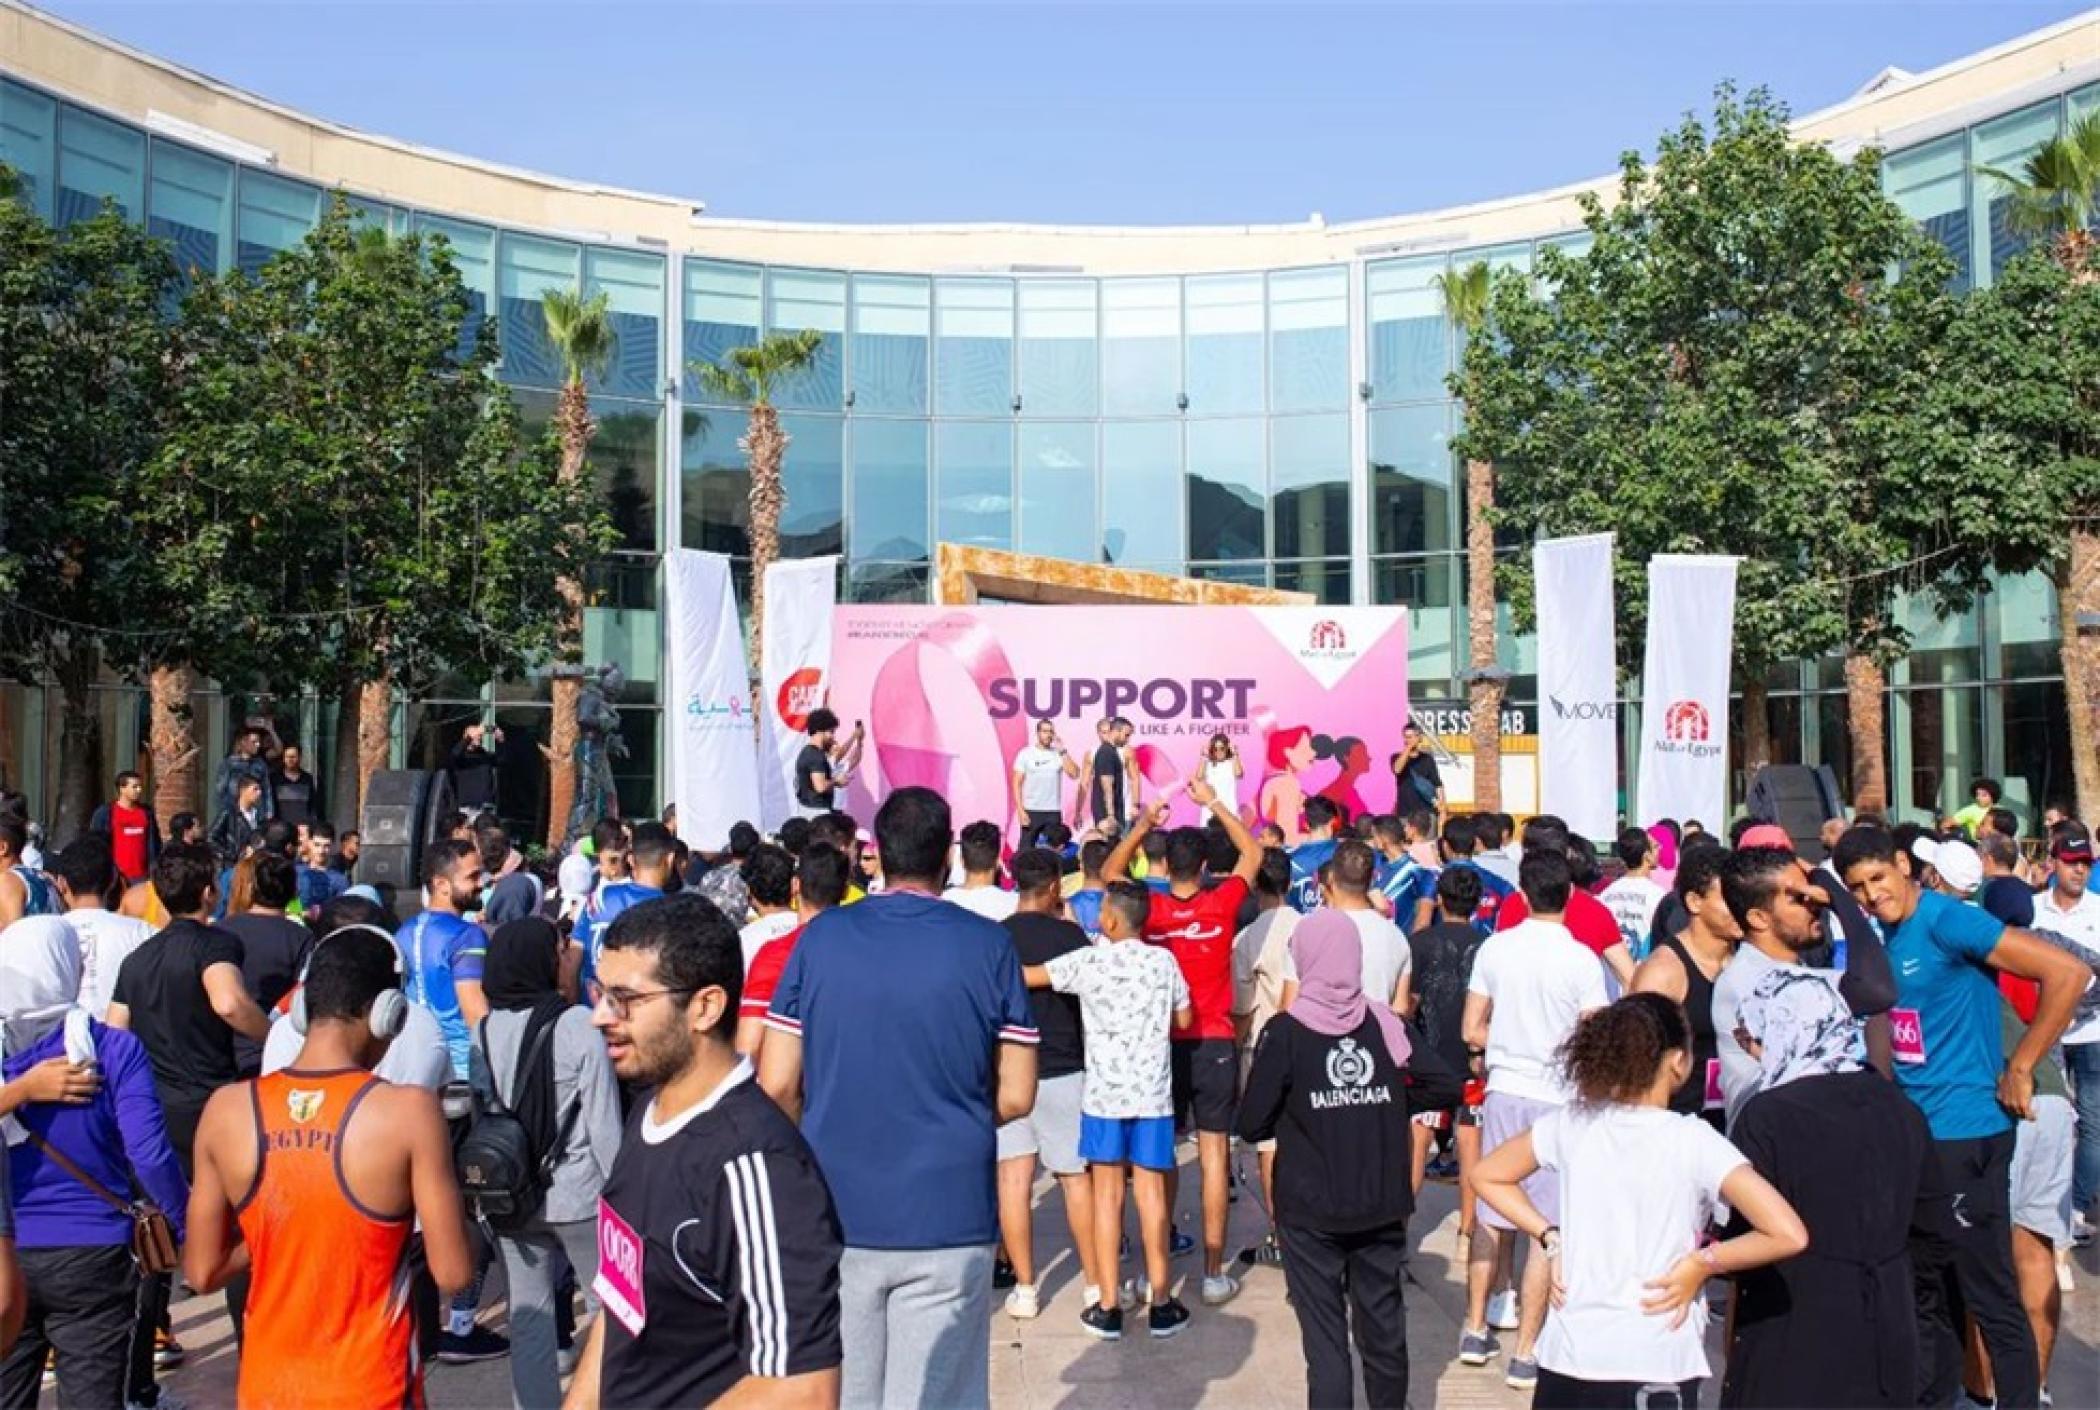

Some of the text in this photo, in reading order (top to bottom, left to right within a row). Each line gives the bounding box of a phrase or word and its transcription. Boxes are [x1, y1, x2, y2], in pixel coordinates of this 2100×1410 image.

[988, 677, 1257, 719] SUPPORT
[1140, 723, 1250, 735] LIKE A FIGHTER
[1501, 710, 1525, 734] AB
[263, 1129, 337, 1153] EGYPT
